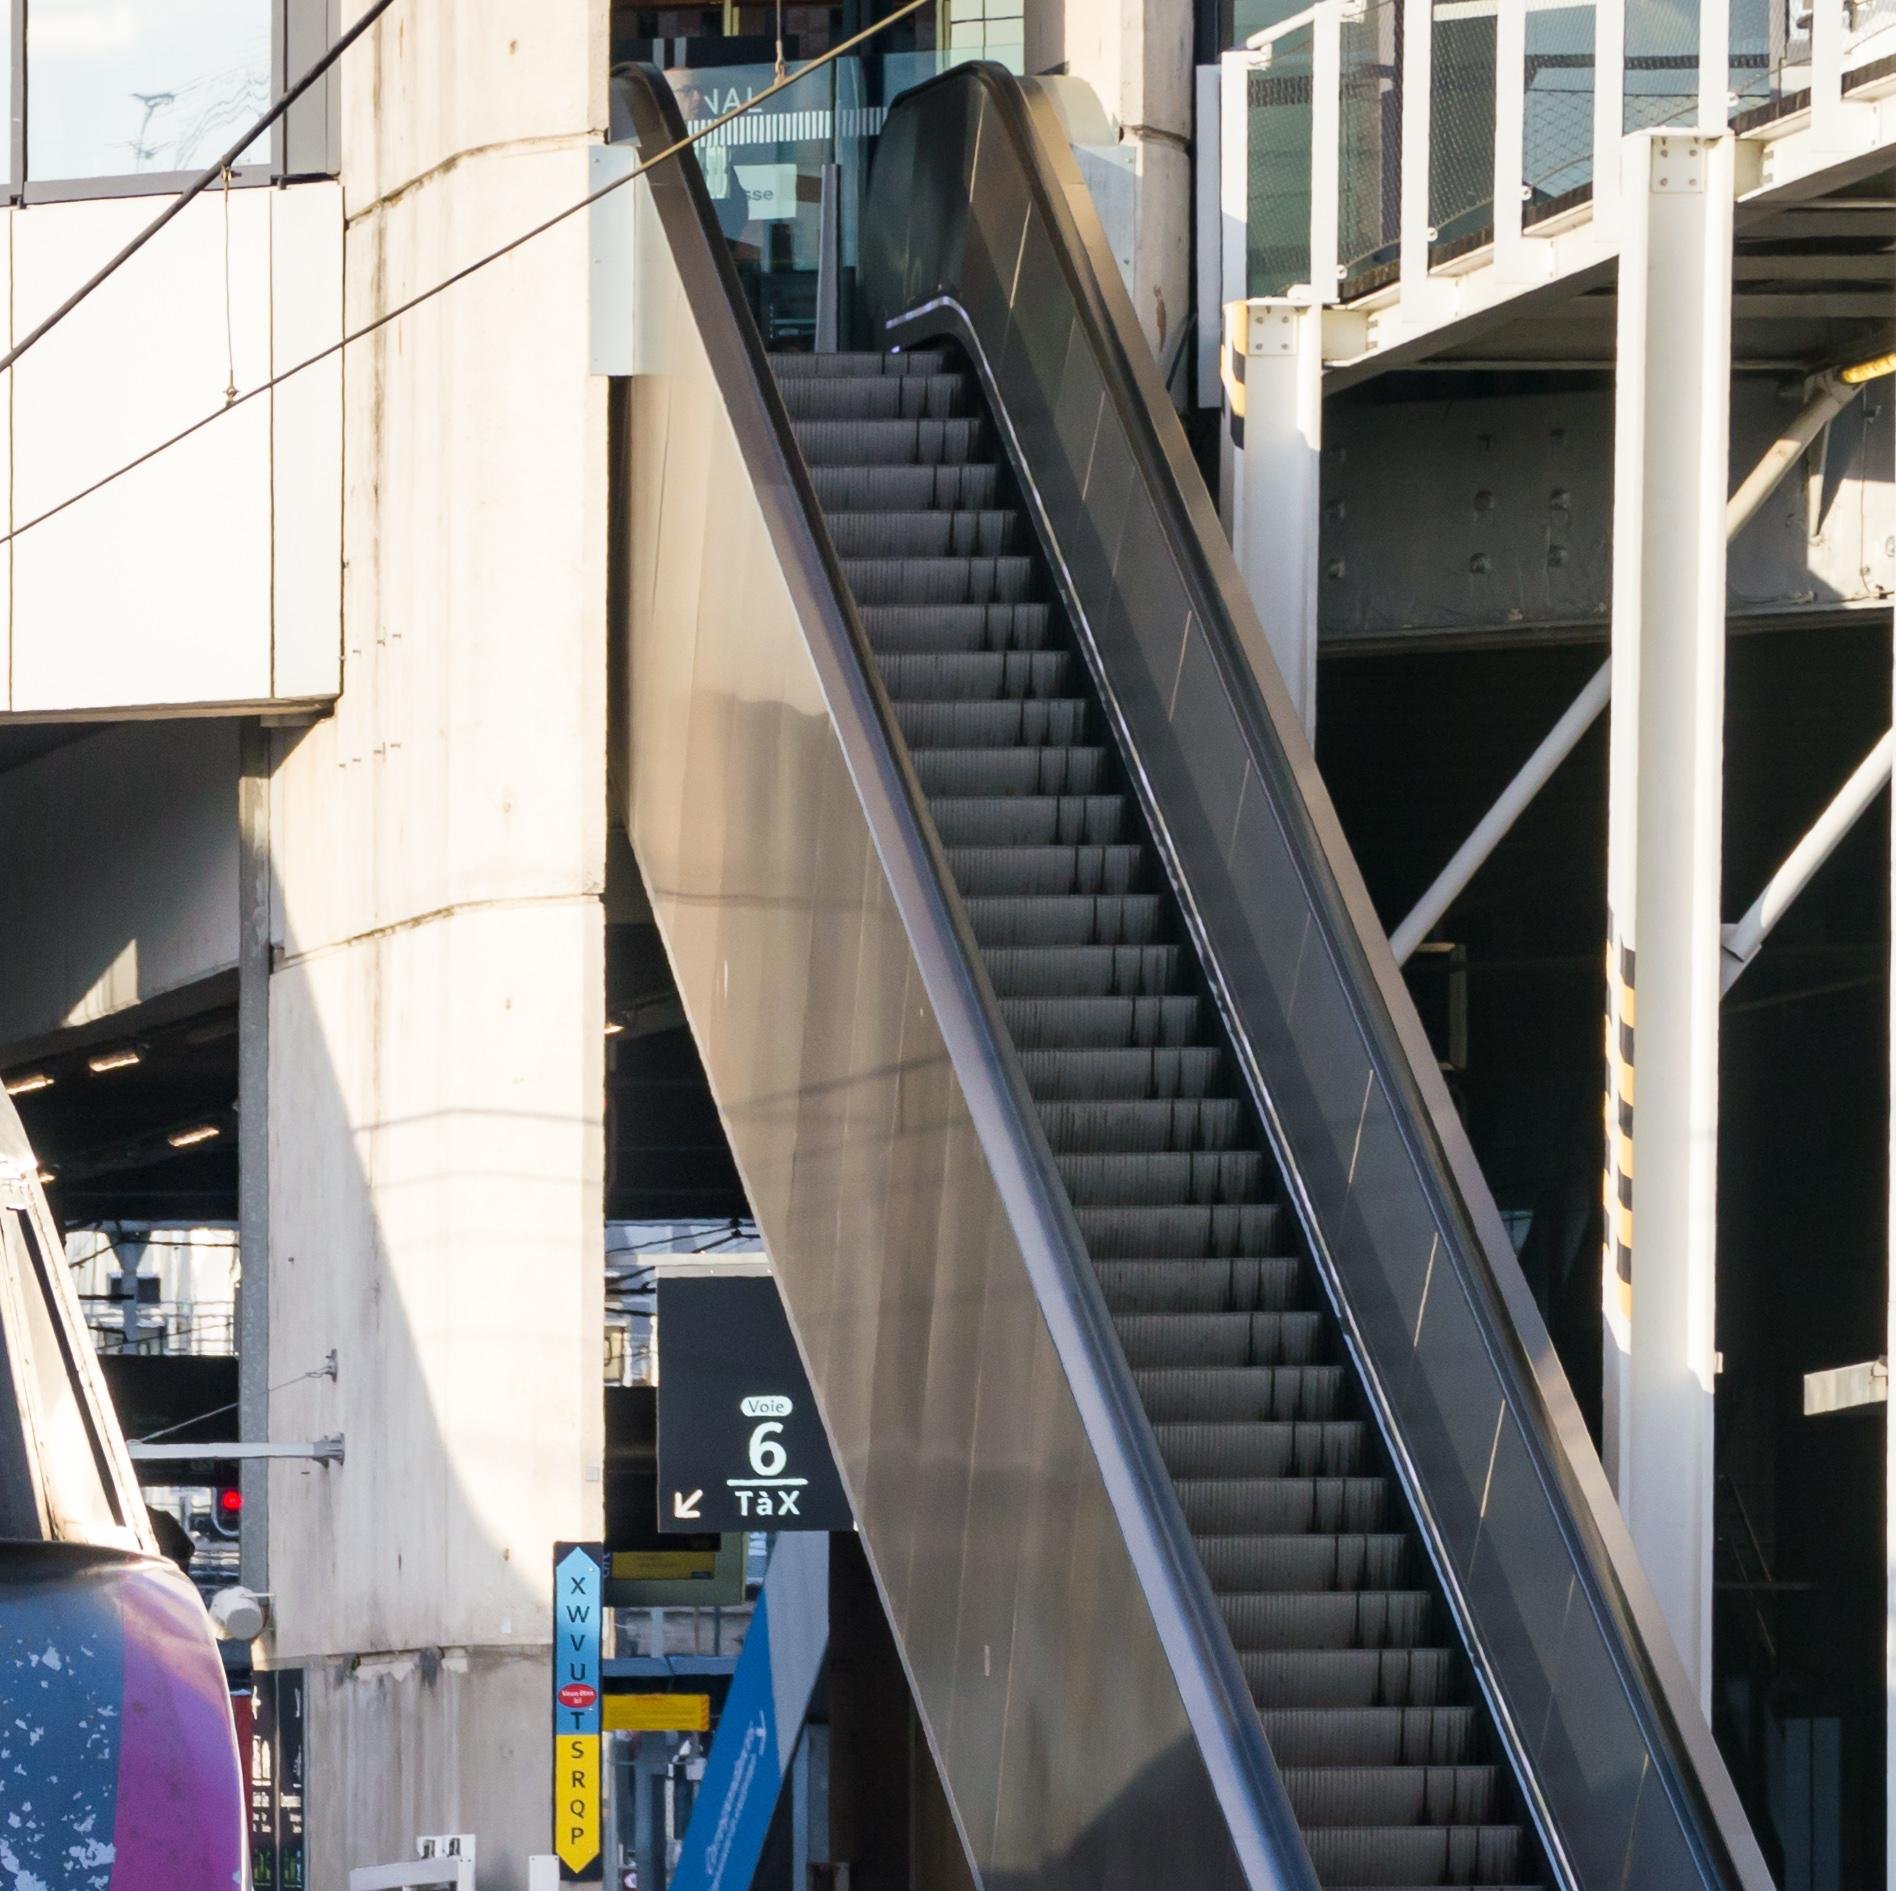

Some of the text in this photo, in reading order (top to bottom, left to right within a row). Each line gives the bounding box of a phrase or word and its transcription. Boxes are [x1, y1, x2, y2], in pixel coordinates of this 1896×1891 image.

[748, 1400, 784, 1413] Voie
[749, 1421, 787, 1476] 6
[570, 1576, 586, 1595] X
[566, 1605, 590, 1623] W
[570, 1634, 585, 1652] V
[570, 1663, 586, 1681] U
[570, 1711, 585, 1730] T
[571, 1740, 584, 1759] S
[572, 1770, 586, 1789] R
[570, 1799, 585, 1819] Q
[571, 1827, 584, 1845] P
